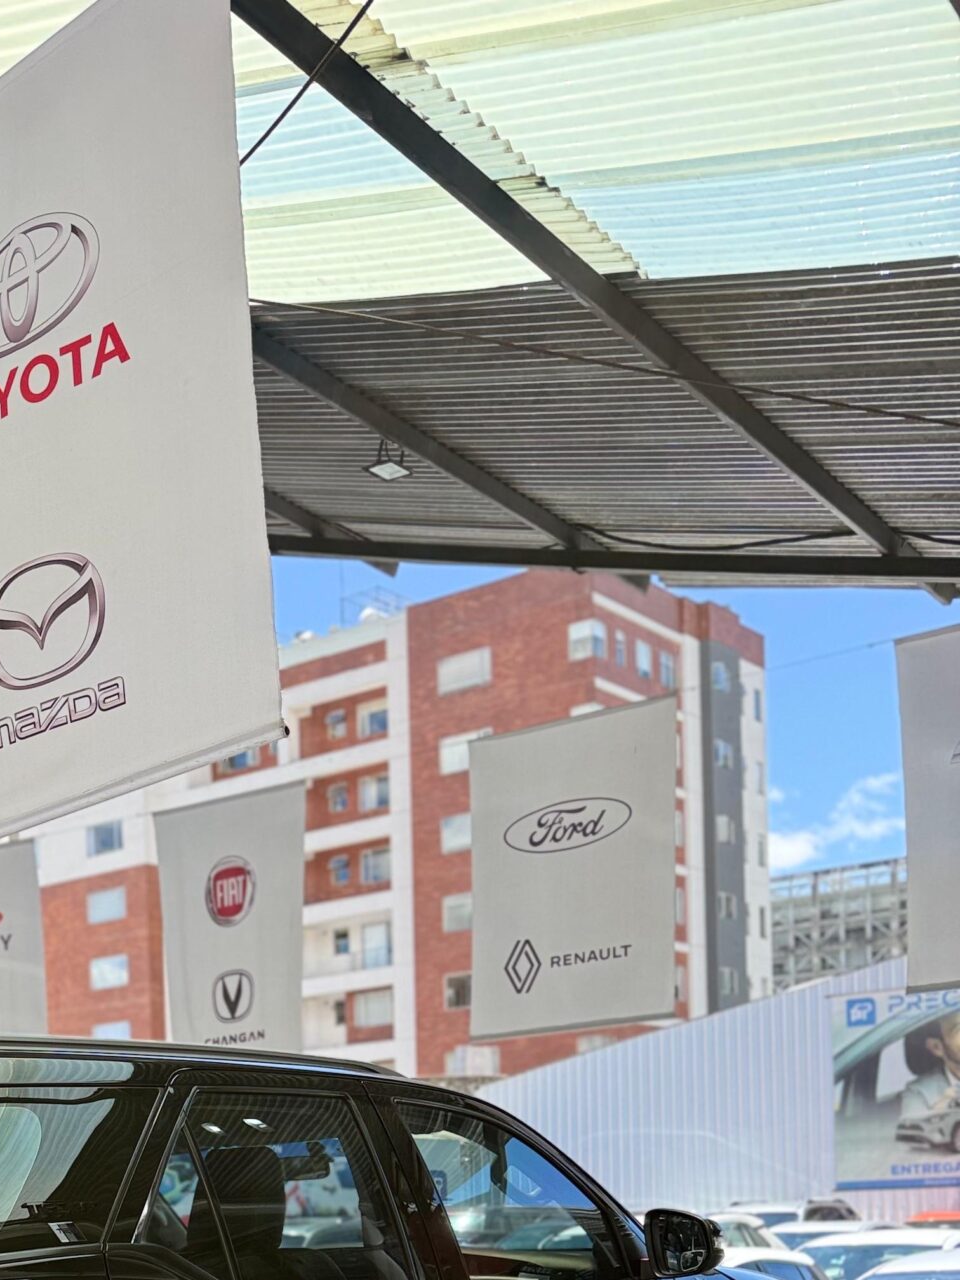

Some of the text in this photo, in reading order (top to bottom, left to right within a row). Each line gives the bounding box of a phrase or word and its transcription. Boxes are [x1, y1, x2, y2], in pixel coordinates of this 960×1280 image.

[529, 806, 606, 847] Ford
[216, 876, 246, 908] FIAT
[550, 944, 632, 968] RENAULT
